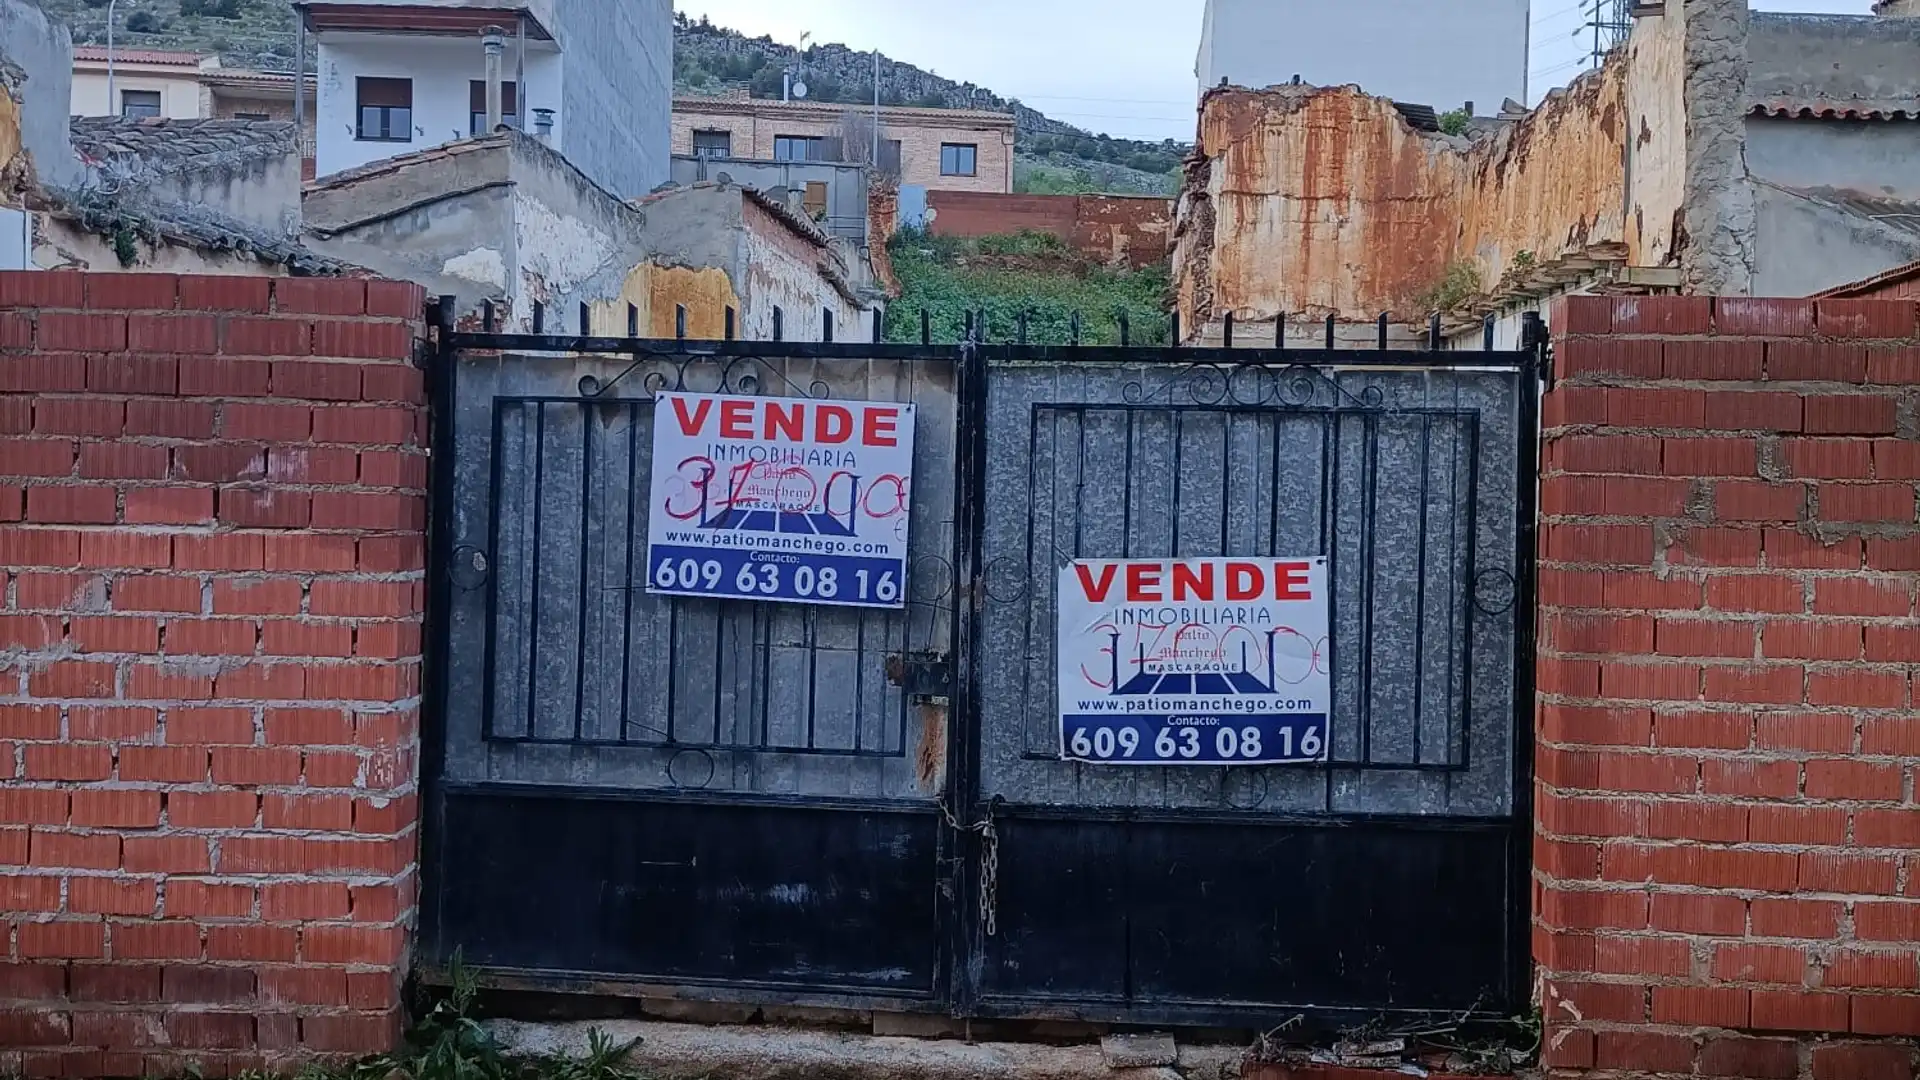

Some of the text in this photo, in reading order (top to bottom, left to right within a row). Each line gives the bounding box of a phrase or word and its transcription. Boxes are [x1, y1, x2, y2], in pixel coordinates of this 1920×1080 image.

[671, 398, 898, 447] VENDE
[707, 443, 857, 468] INMOBILIARIA
[736, 500, 820, 511] MASCARAQUE
[666, 530, 889, 555] www.patiomanchego.com
[750, 552, 800, 564] Contacto:
[655, 558, 897, 601] 609 63 08 16
[1075, 562, 1312, 602] VENDE
[1115, 607, 1271, 625] INMOBILIARIA
[1148, 663, 1238, 672] MASCARAQUE
[1078, 698, 1312, 713] www.patiomanchego.com
[1167, 716, 1220, 726] Contacto:
[1071, 726, 1321, 758] 609 63 08 16
